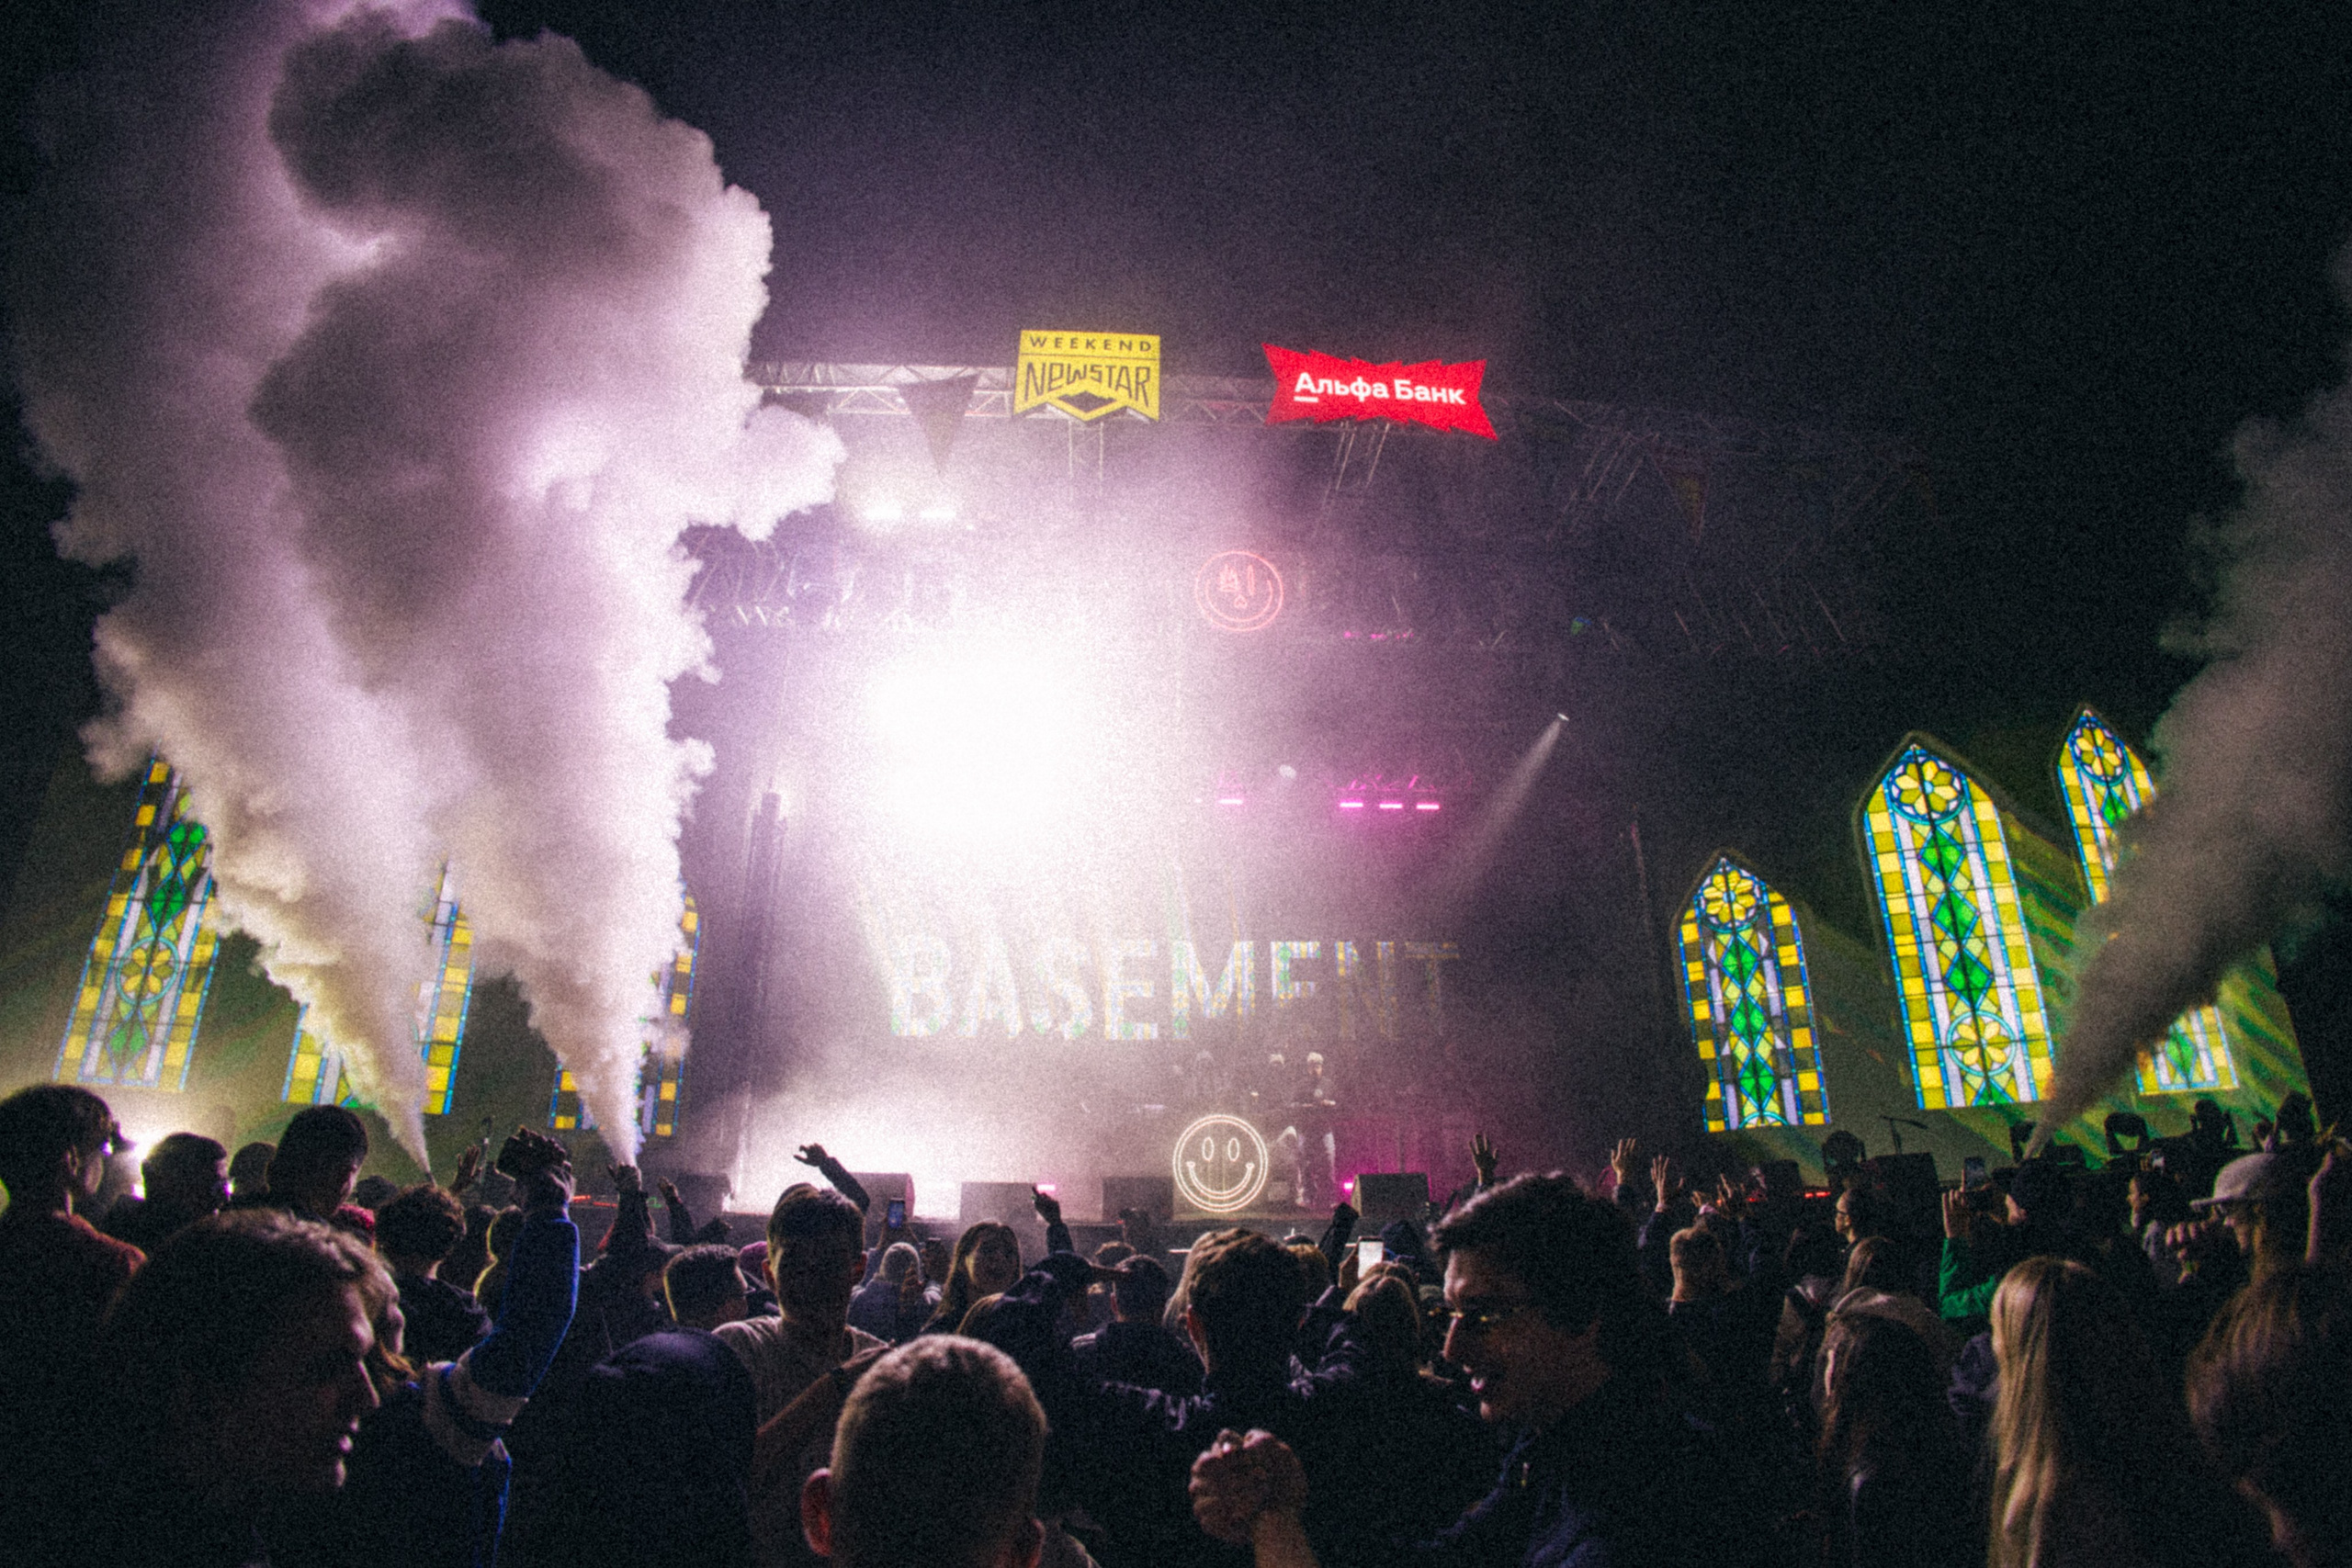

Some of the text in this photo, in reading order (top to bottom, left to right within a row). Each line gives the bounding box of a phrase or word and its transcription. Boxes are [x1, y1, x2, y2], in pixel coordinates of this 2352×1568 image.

[1030, 336, 1151, 352] WEEKEND
[1294, 372, 1466, 404] Альфа Банк
[890, 933, 1459, 1040] BASEMENT
